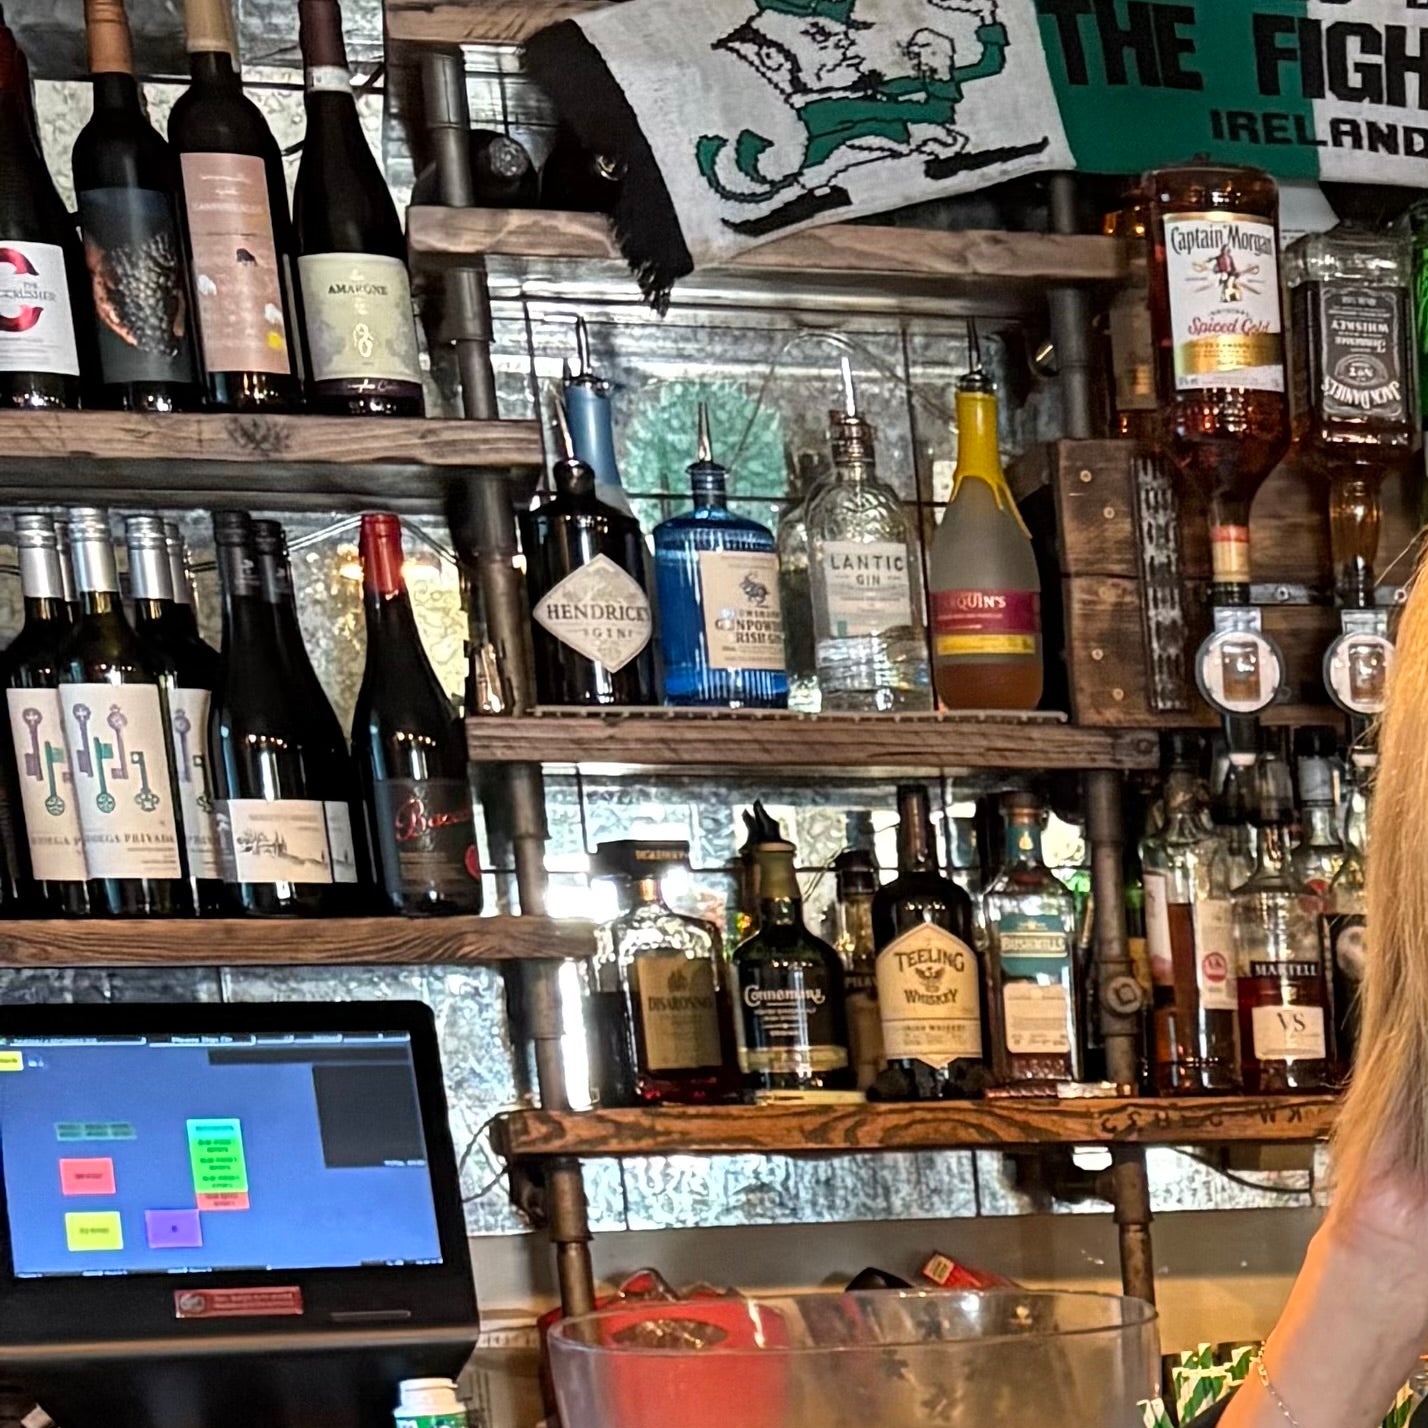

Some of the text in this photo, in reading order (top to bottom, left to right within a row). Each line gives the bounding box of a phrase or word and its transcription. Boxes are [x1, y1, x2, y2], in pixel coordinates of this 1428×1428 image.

[1031, 0, 1204, 92] THE
[1170, 225, 1273, 257] Captain Morgan
[327, 283, 388, 296] AMARONE
[1187, 316, 1238, 337] Spiced
[1370, 380, 1402, 407] JACK
[830, 555, 904, 572] LANTIC
[856, 574, 881, 586] GIN
[893, 948, 966, 973] TEELING
[1254, 962, 1318, 977] MARTELL
[903, 988, 959, 1007] WHISKEY
[1278, 1011, 1307, 1033] VS
